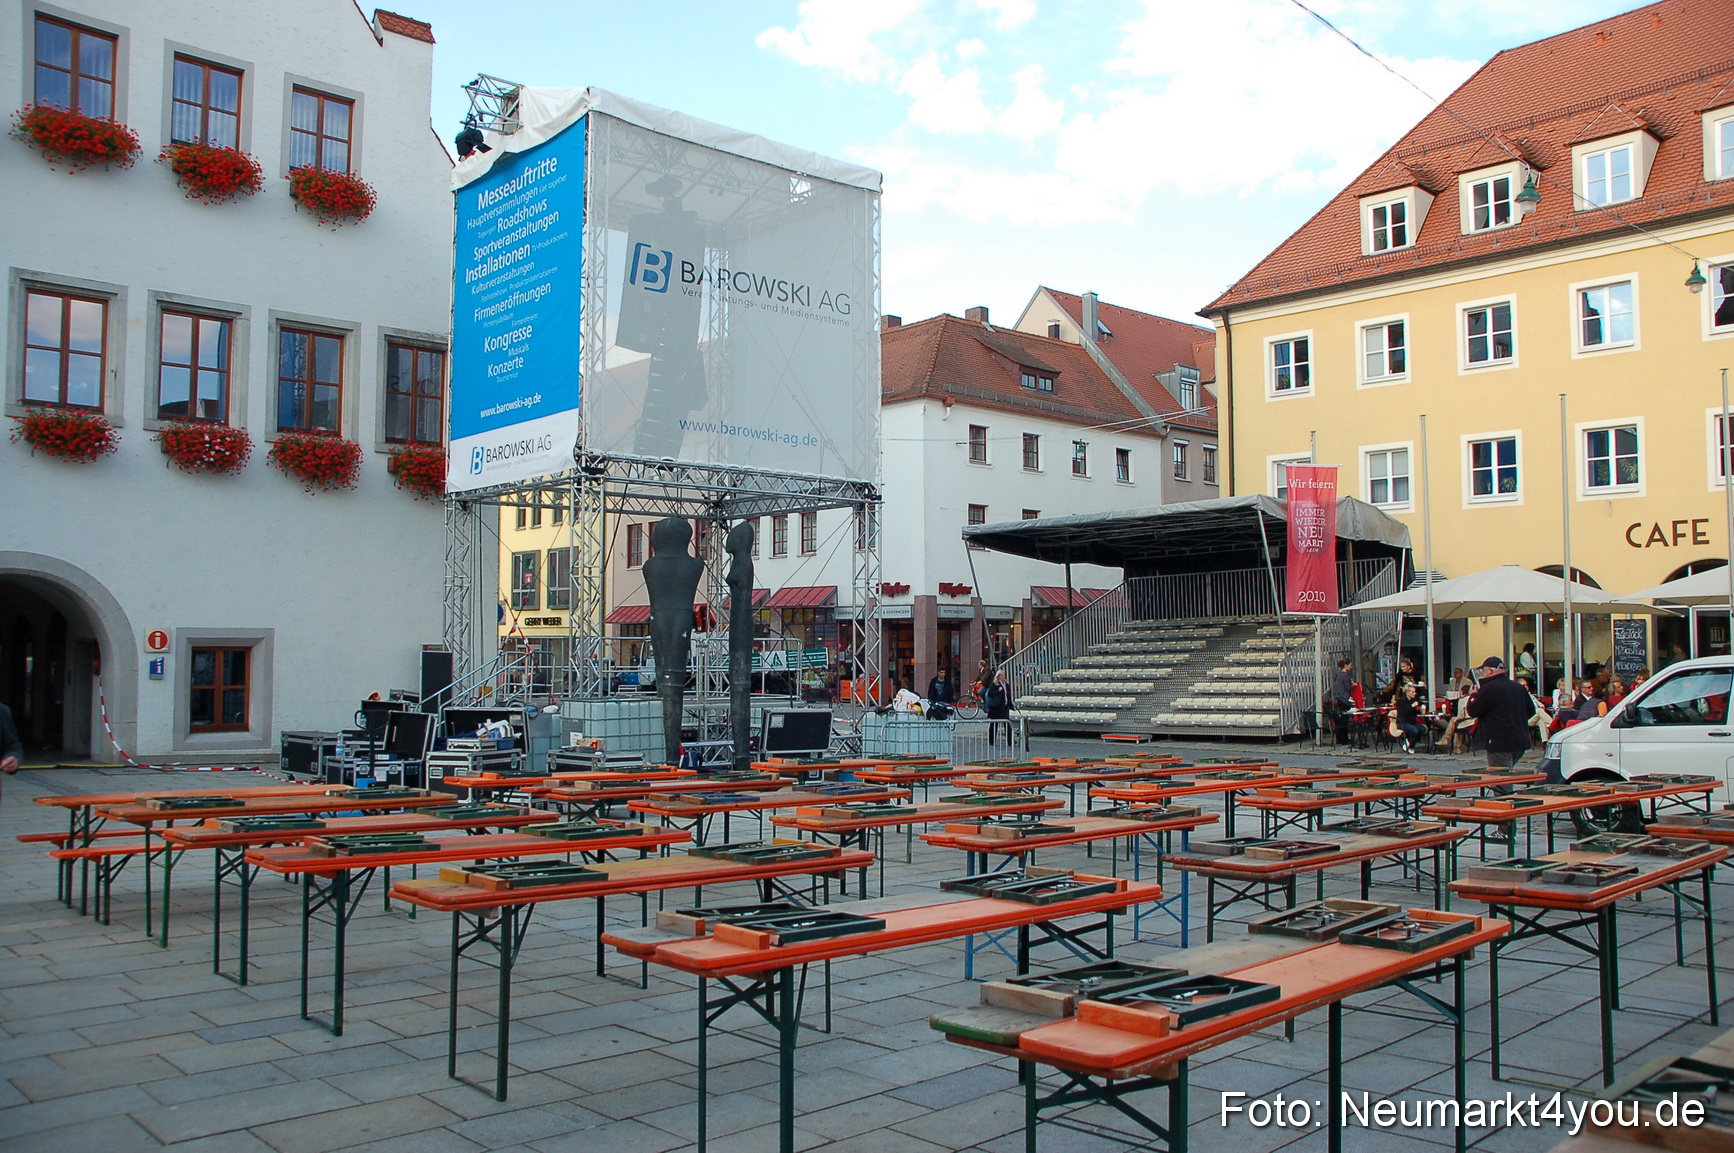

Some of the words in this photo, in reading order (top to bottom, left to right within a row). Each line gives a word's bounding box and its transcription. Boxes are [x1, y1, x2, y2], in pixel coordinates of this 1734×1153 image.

[478, 156, 558, 211] Messeauftritte
[467, 187, 539, 230] Hauptversammlungen
[497, 198, 548, 233] Roadshows
[474, 211, 559, 262] Sportveranstaltungen
[465, 243, 531, 284] Installationen
[471, 261, 535, 295] Kulturveranstaltungen
[681, 260, 811, 307] BAROWSKI
[818, 290, 851, 315] AG
[474, 282, 551, 323] Firmeneröffnungen
[681, 286, 758, 309] Verasaltungs-
[761, 302, 778, 313] und
[781, 306, 850, 327] Mediensysteme
[484, 325, 533, 353] Kongresse
[508, 343, 530, 357] Musicals
[487, 356, 524, 378] Konzerte
[480, 392, 542, 419] www.barowski-ag.de
[679, 419, 818, 447] www.barowski-ag.de
[486, 438, 535, 464] BAROWSKI
[536, 434, 552, 453] AG
[1289, 478, 1306, 489] Wir
[1308, 478, 1335, 490] feiern
[1295, 517, 1326, 526] WIEDER
[1296, 508, 1325, 517] IMMER
[1297, 526, 1324, 539] NEU
[1625, 518, 1710, 548] CAFE
[1298, 591, 1326, 603] 2010
[525, 617, 542, 626] GERRY
[542, 616, 562, 626] WEBER
